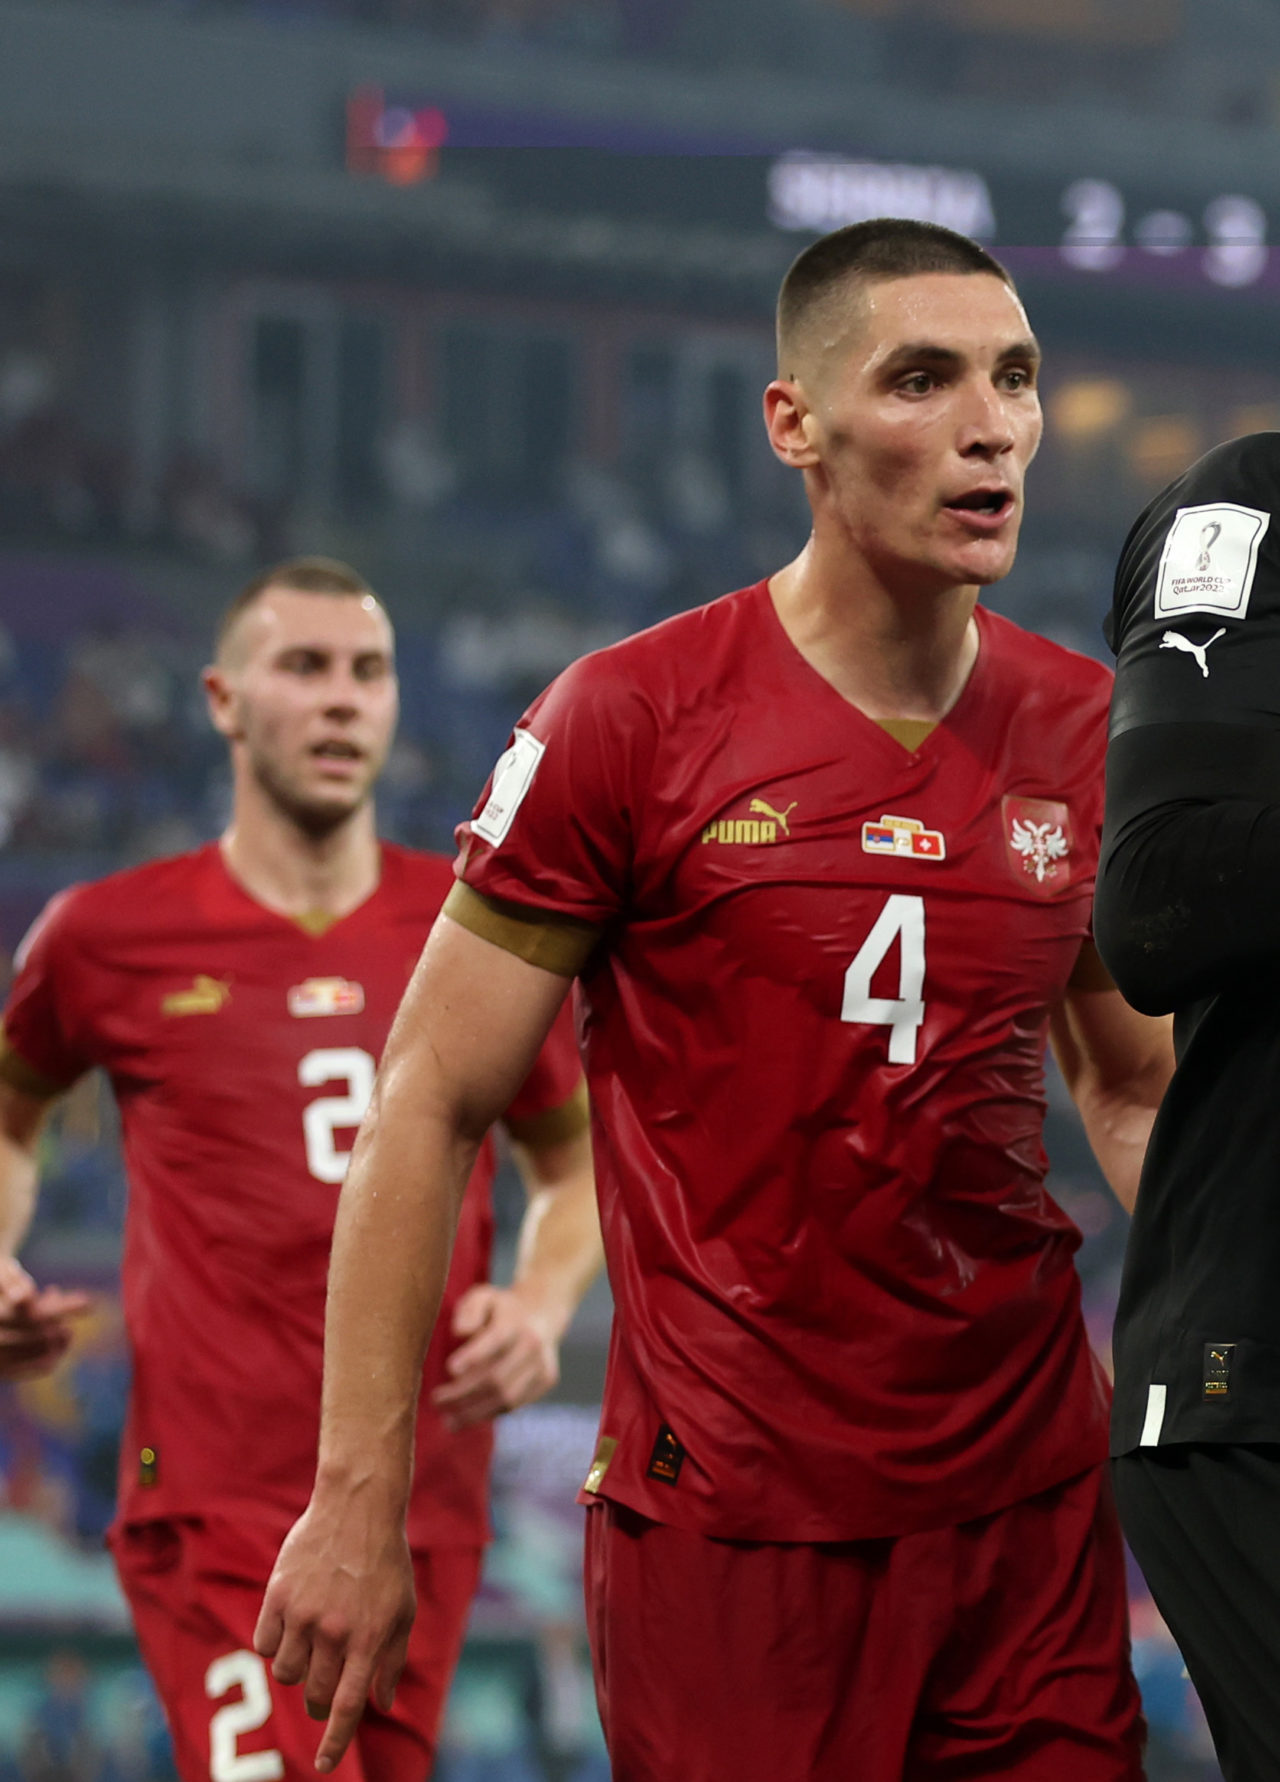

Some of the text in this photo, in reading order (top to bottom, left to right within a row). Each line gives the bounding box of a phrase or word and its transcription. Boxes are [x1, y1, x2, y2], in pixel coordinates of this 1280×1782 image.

[1187, 576, 1213, 584] WORLD
[702, 819, 776, 845] PUMA
[841, 894, 926, 1065] 4
[297, 1047, 377, 1184] 2
[204, 1649, 286, 1782] 2
